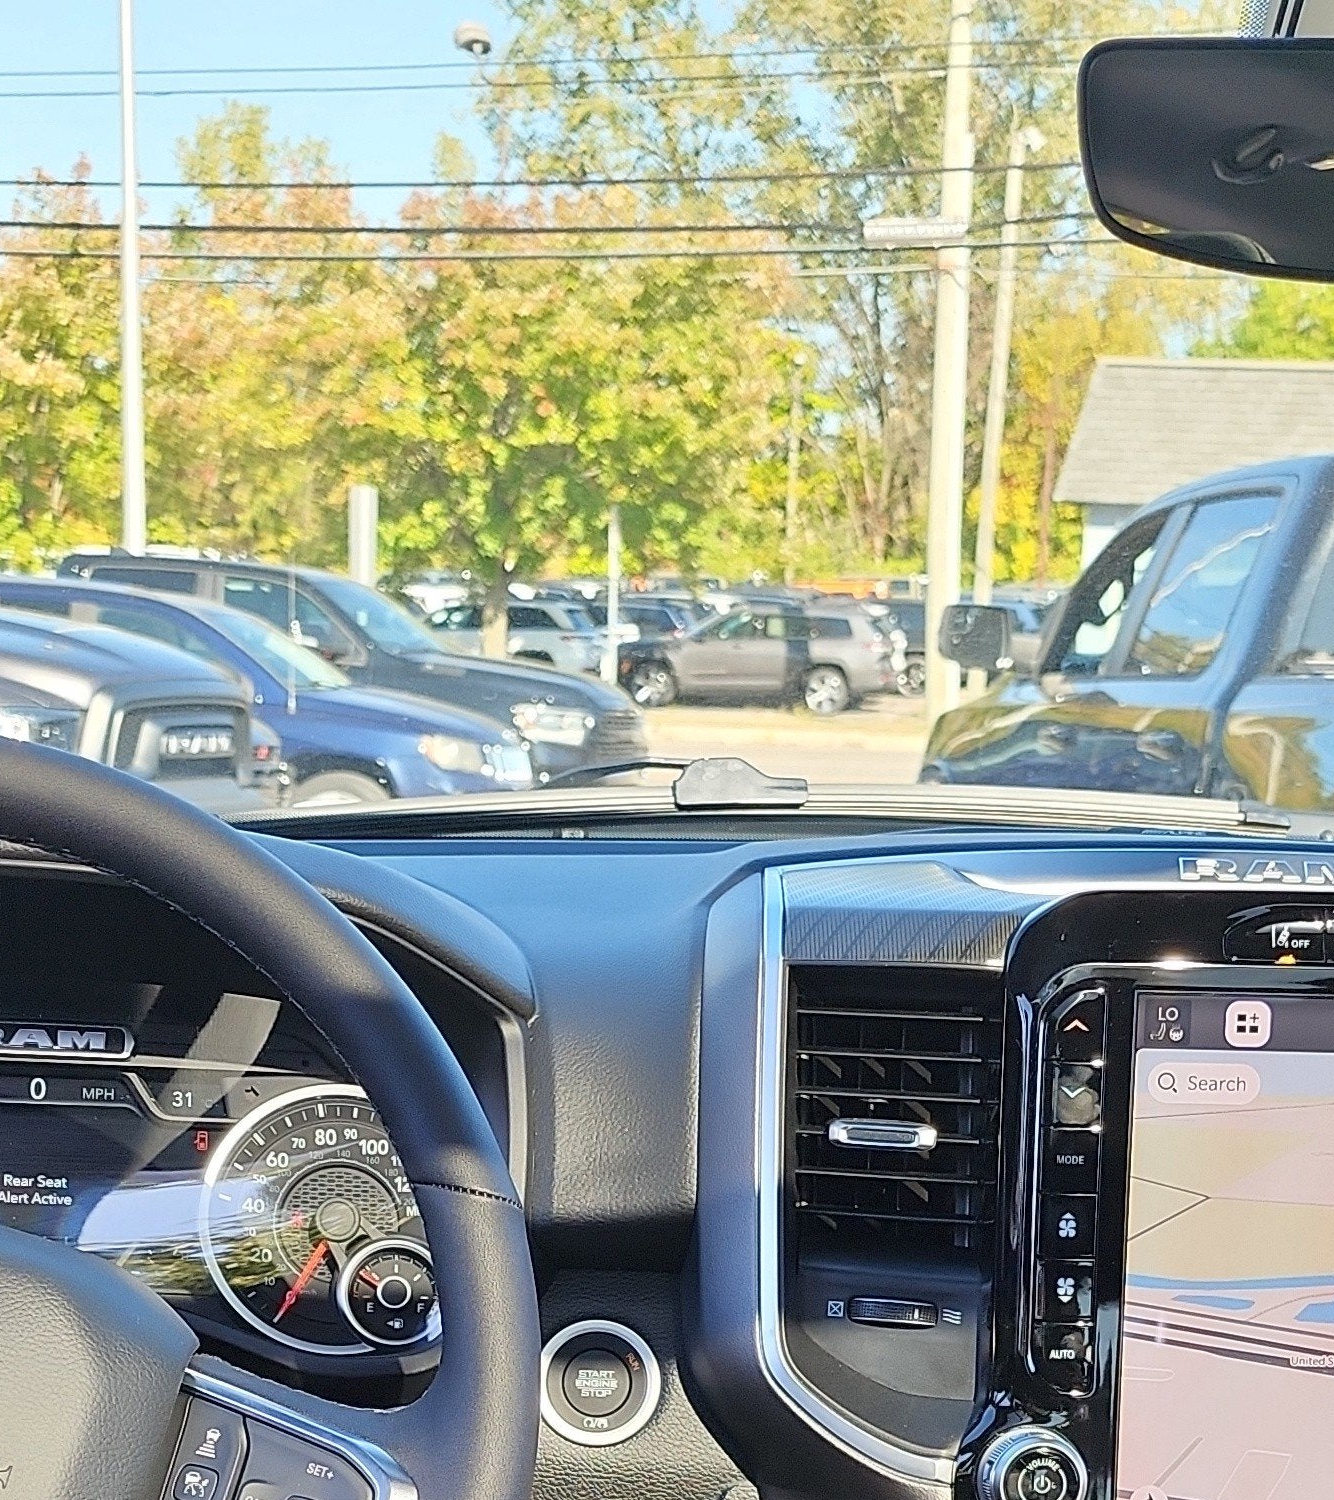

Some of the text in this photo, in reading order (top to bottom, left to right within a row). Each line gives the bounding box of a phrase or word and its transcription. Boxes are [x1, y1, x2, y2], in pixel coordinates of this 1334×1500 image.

[1291, 939, 1311, 949] OFF
[1158, 1006, 1179, 1022] LO
[29, 1077, 116, 1101] 0 MPH
[1187, 1075, 1247, 1092] Search
[172, 1091, 193, 1108] 31
[315, 1129, 337, 1146] 80
[344, 1128, 358, 1140] 90
[291, 1138, 307, 1150] 70
[359, 1139, 389, 1155] 100
[266, 1152, 289, 1168] 60
[1056, 1154, 1085, 1165] MODE
[3, 1175, 68, 1188] Rear Seat
[31, 1192, 73, 1206] Active
[242, 1198, 265, 1214] 40
[367, 1303, 374, 1313] E
[417, 1302, 425, 1313] F
[1049, 1350, 1075, 1360] AUTO
[1290, 1356, 1326, 1368] United
[578, 1369, 616, 1379] START
[575, 1378, 619, 1388] ENGINE
[580, 1388, 613, 1398] STOP
[1027, 1458, 1061, 1472] VOLUME
